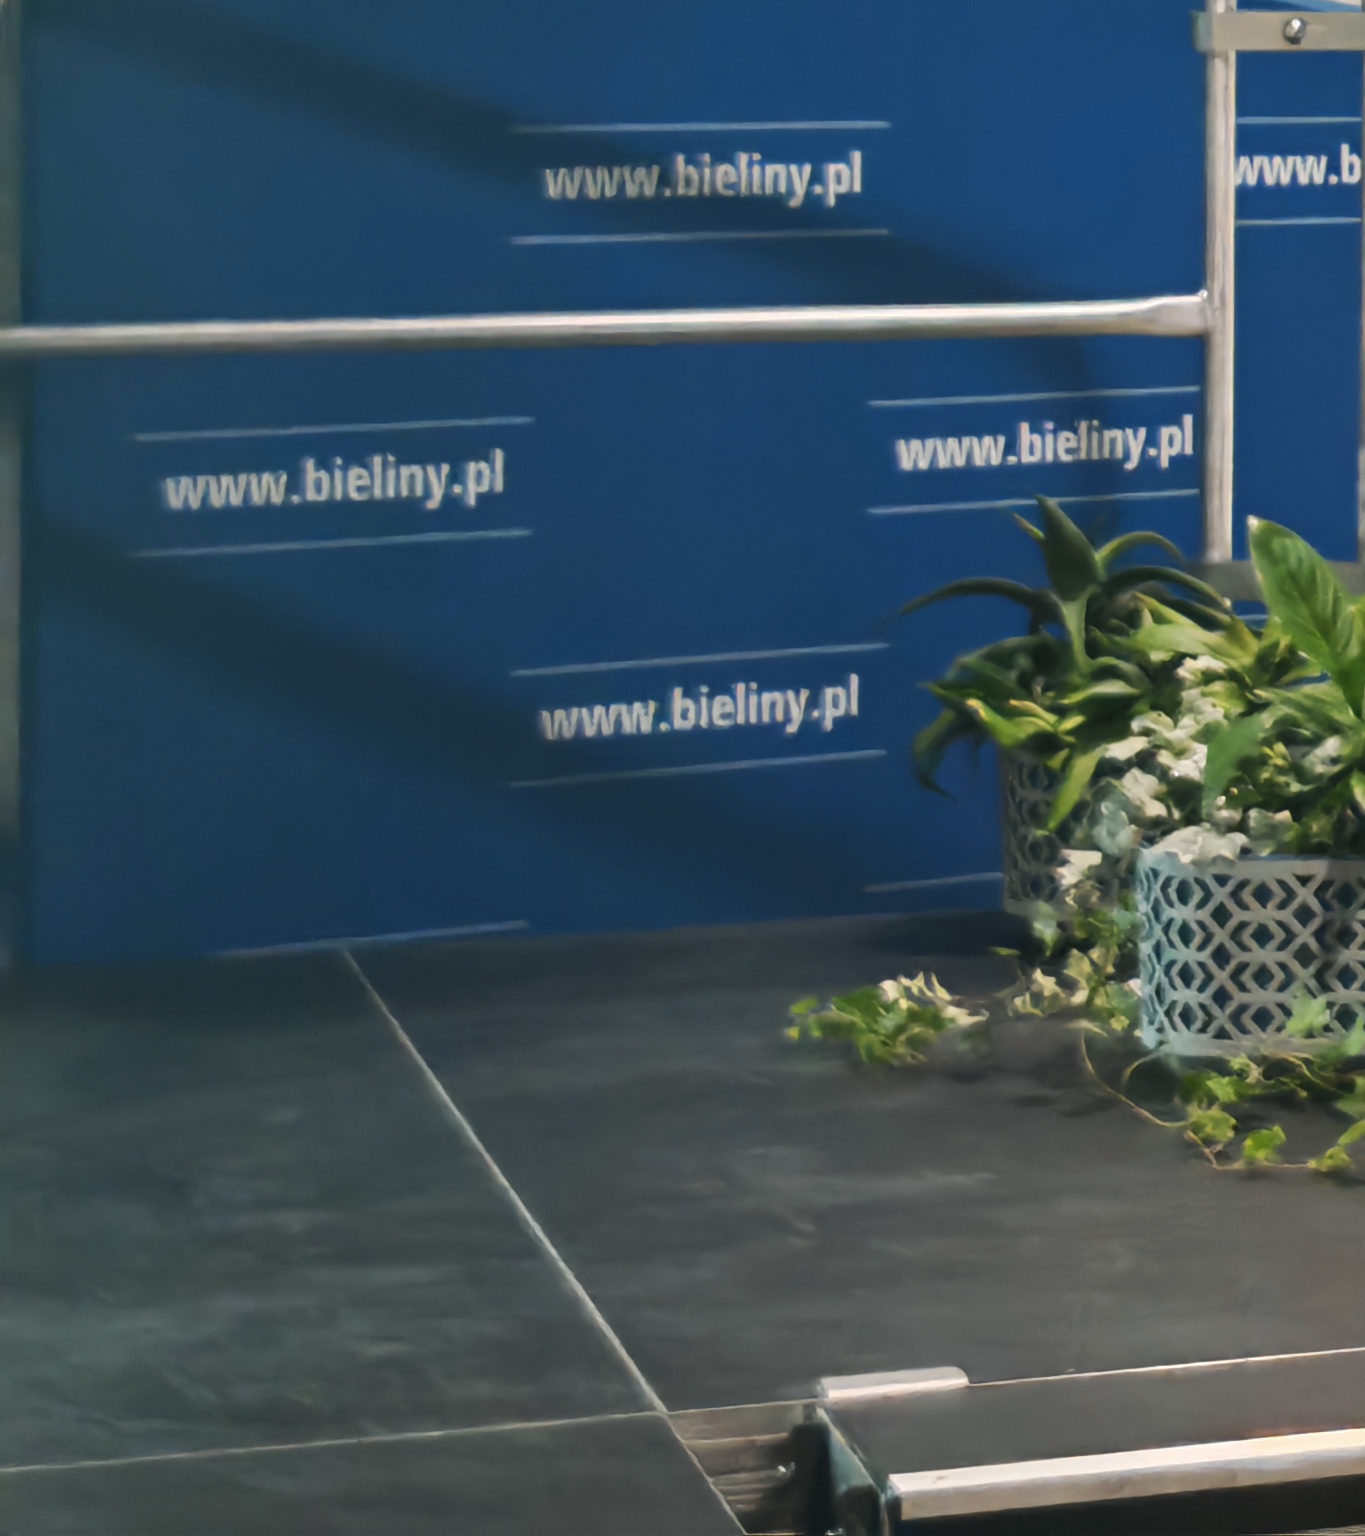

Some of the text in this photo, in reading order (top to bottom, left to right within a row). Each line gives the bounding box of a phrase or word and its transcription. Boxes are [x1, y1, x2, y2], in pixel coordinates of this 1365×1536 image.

[544, 150, 863, 208] www.bieliny.pl
[894, 413, 1195, 472] www.bieliny.pl
[164, 448, 506, 510] www.bieliny.pl
[540, 673, 860, 741] www.bieliny.pl
